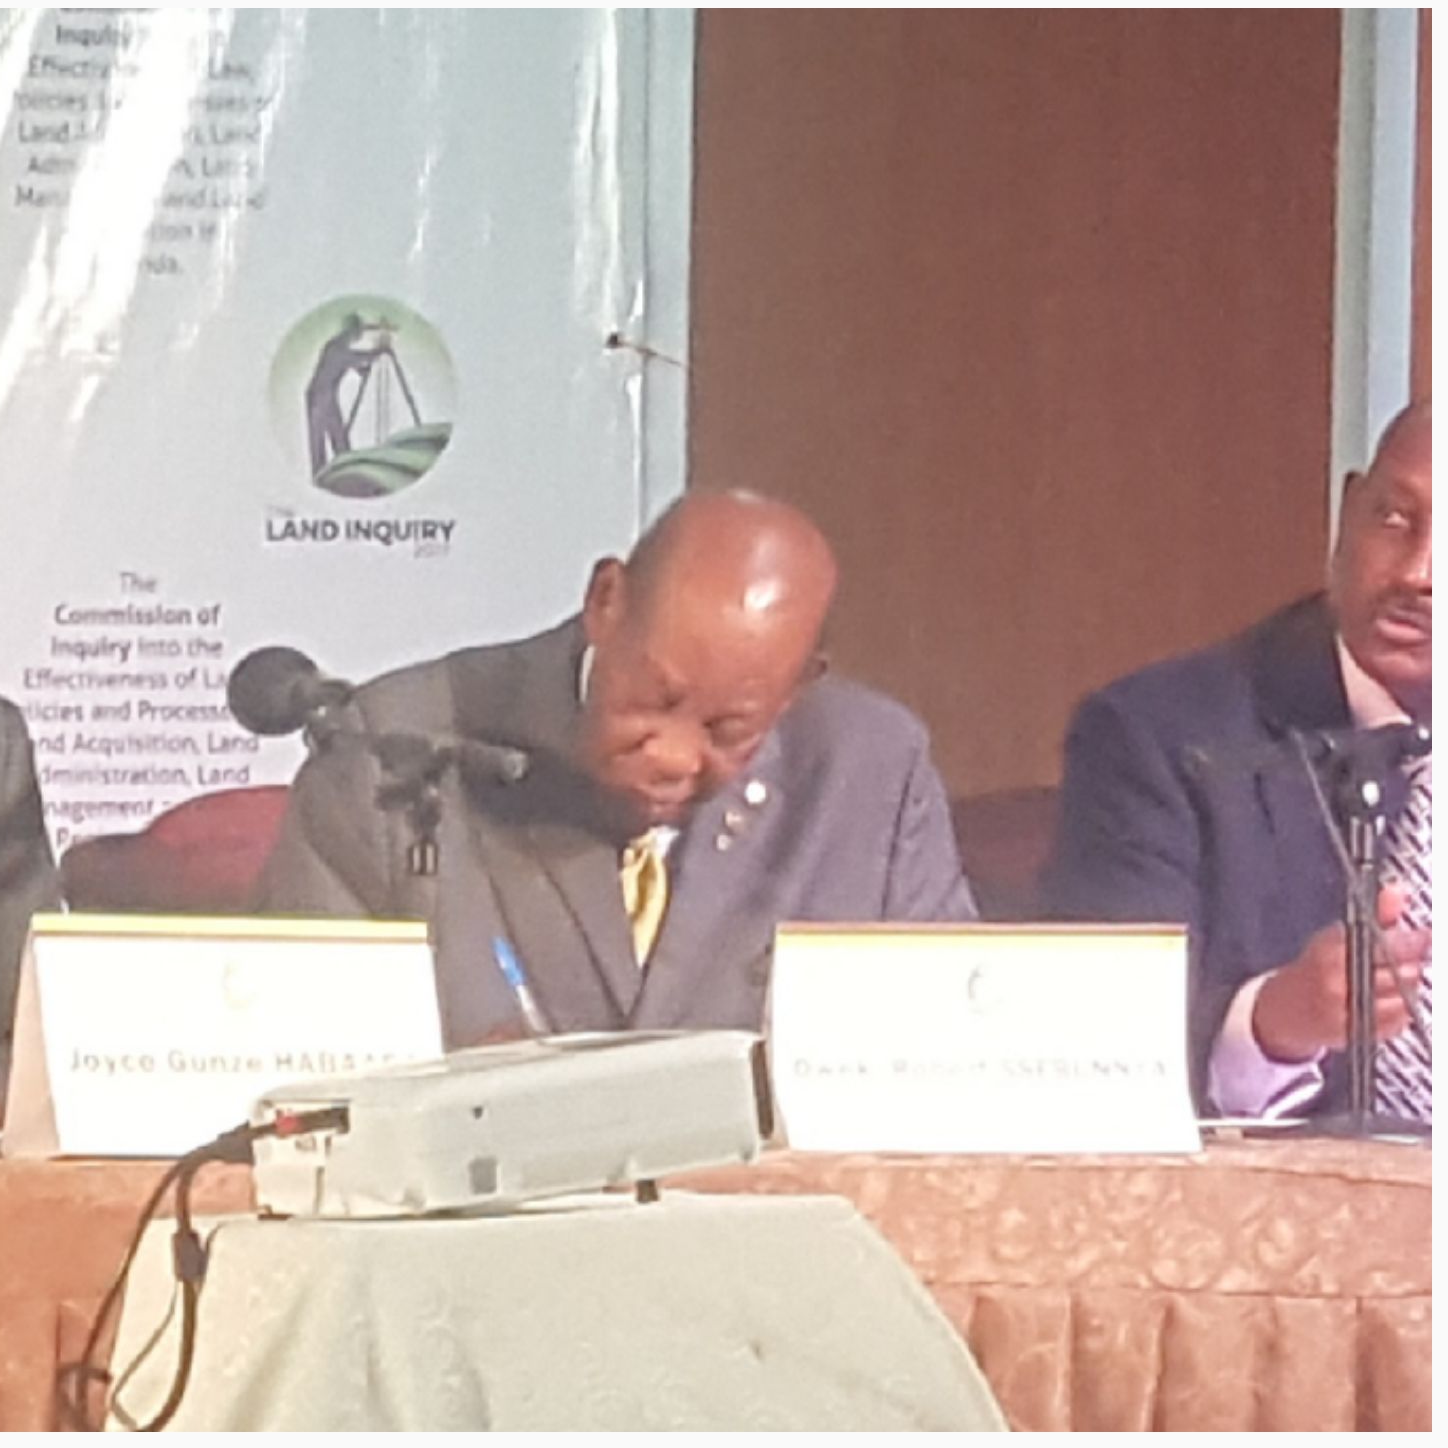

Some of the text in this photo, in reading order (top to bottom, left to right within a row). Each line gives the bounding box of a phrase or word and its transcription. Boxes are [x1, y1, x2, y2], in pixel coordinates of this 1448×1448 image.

[265, 519, 456, 547] LAND INQUIRY
[119, 571, 158, 594] The
[54, 604, 222, 627] Commission of
[51, 636, 224, 663] Inquiry into the
[23, 667, 169, 691] Effectiveness
[174, 667, 198, 690] of
[91, 701, 131, 722] and
[72, 733, 202, 758] Acquisition,
[208, 733, 260, 755] Land
[40, 765, 251, 788] dministration, Land
[71, 1046, 156, 1077] Joyce
[167, 1049, 263, 1074] Gunze
